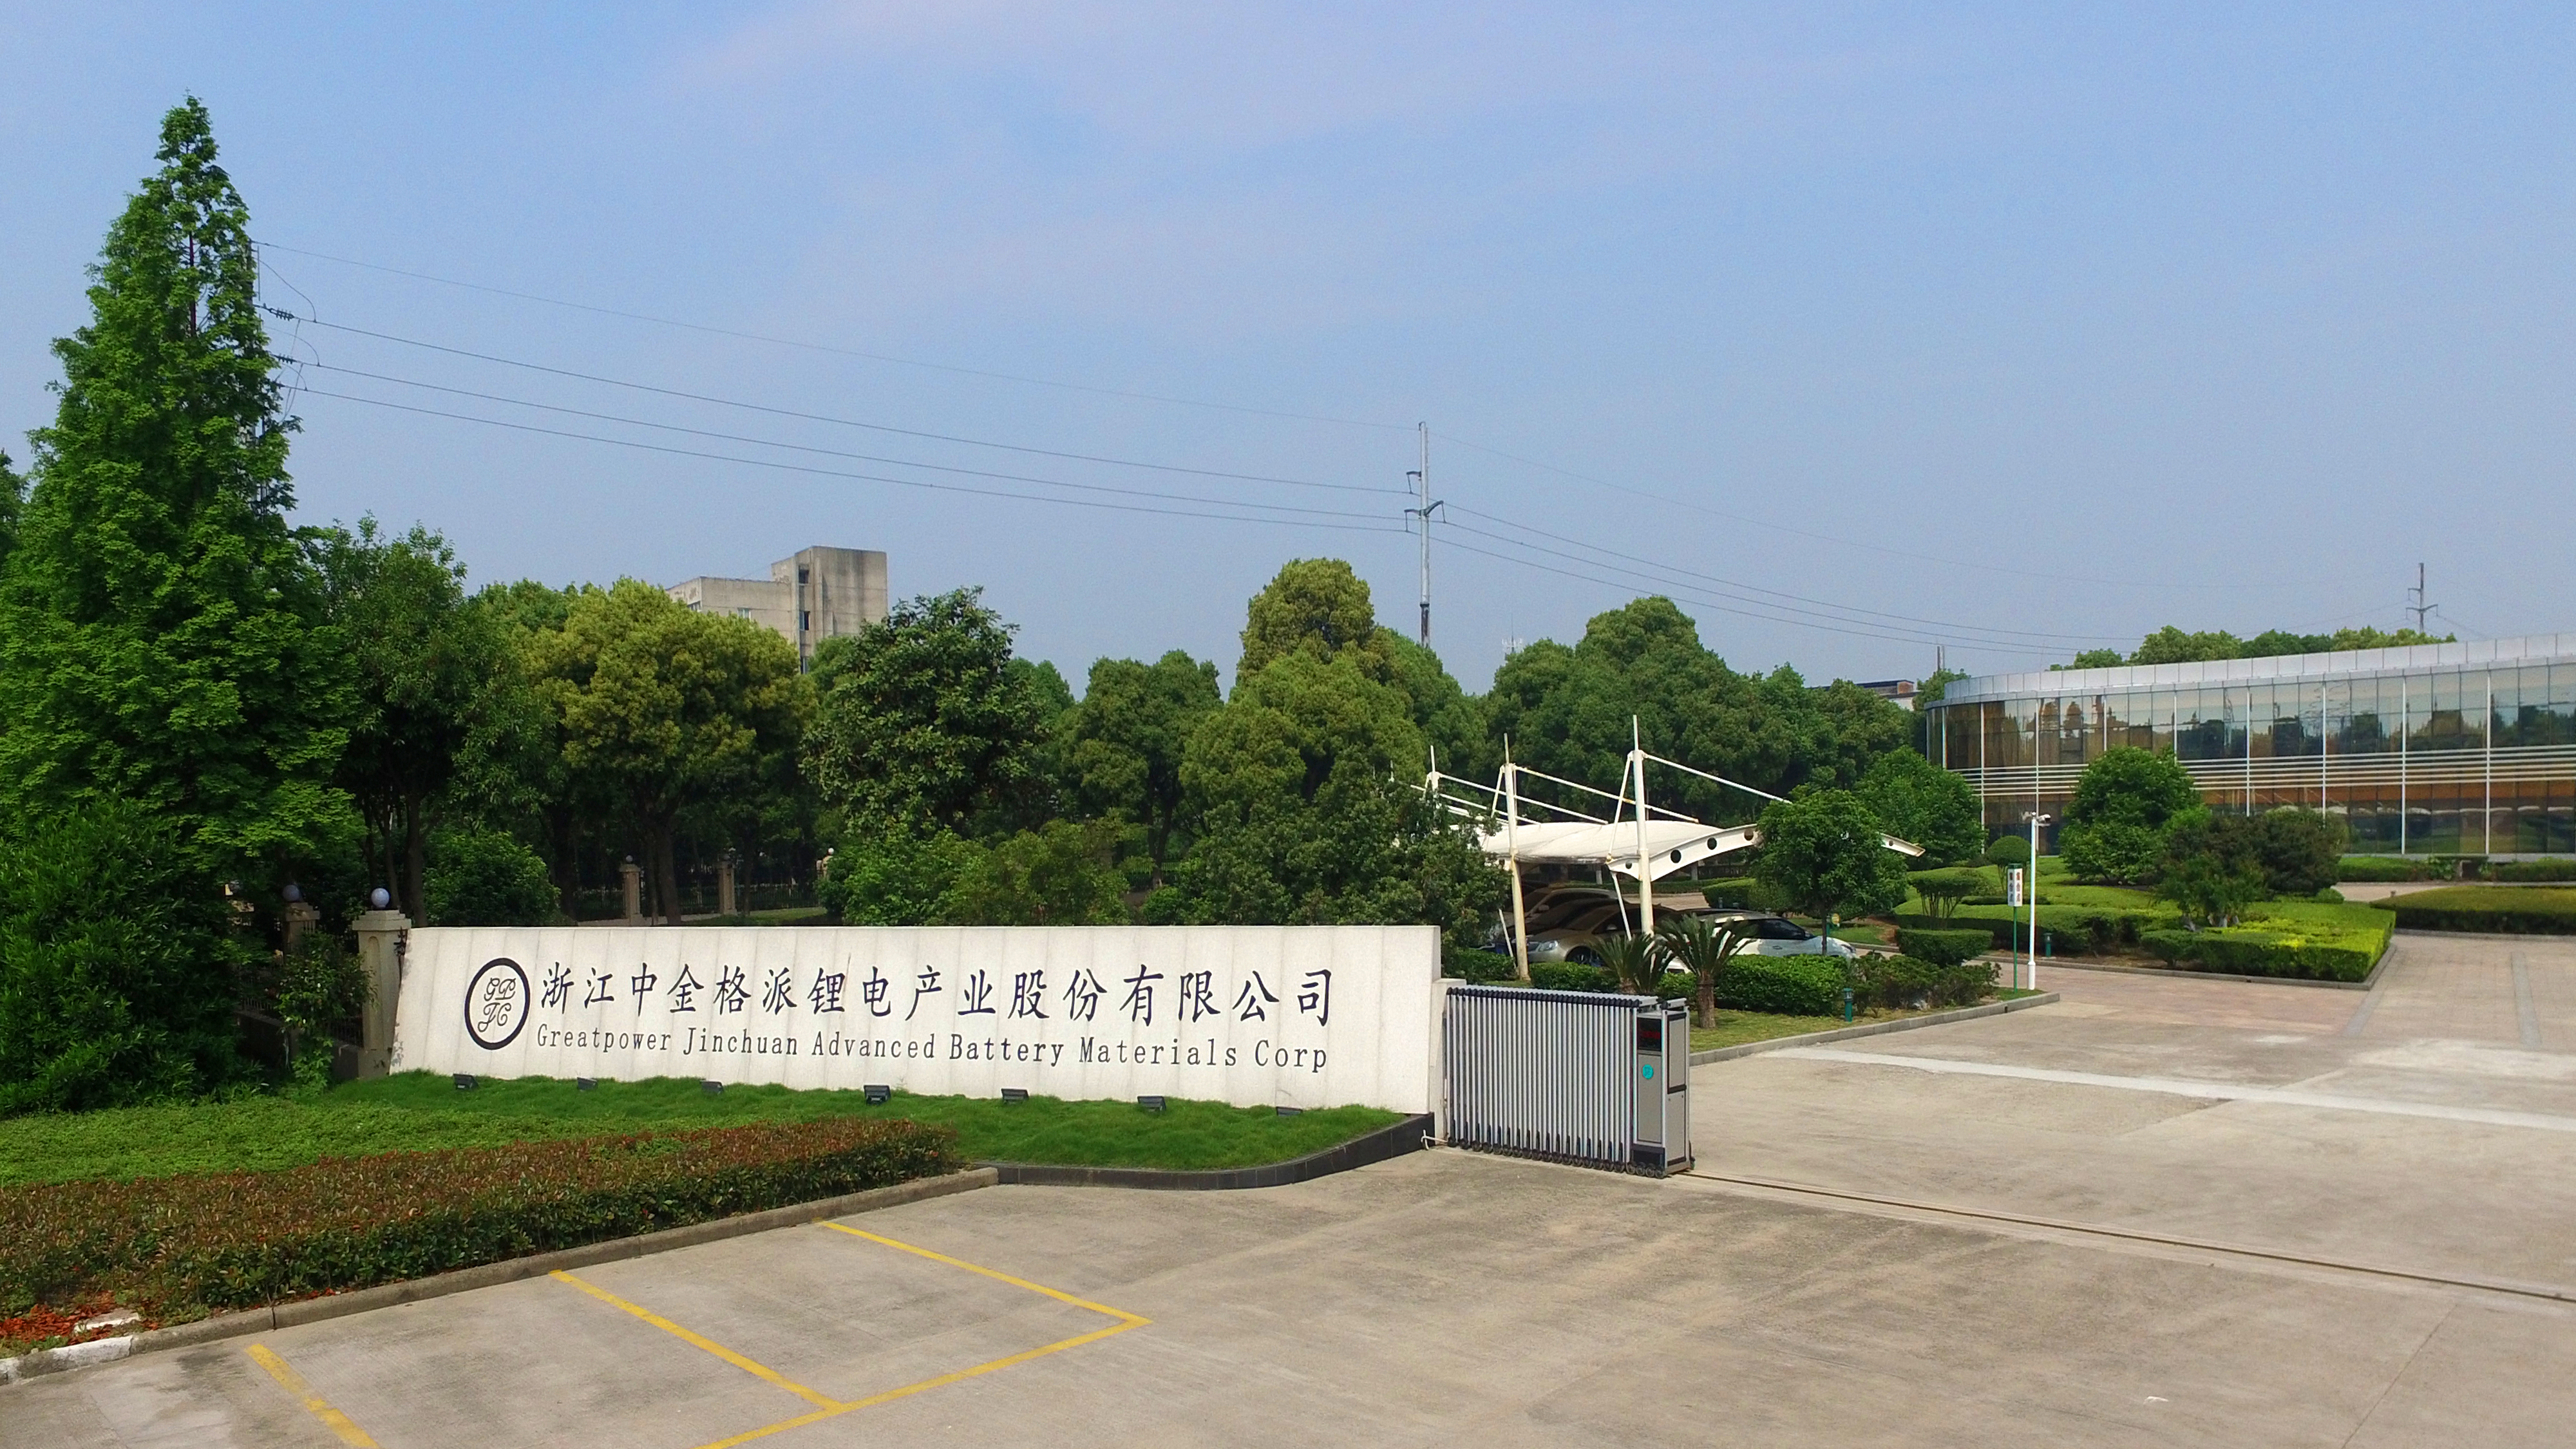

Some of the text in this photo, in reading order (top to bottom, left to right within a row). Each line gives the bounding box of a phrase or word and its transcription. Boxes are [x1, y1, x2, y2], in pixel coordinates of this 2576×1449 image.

[541, 961, 1332, 1027] 浙江中金格派锂电产业股份有限公司
[537, 1023, 1327, 1074] Greatpower Jinchuan Advanced Battery Materials Corp
